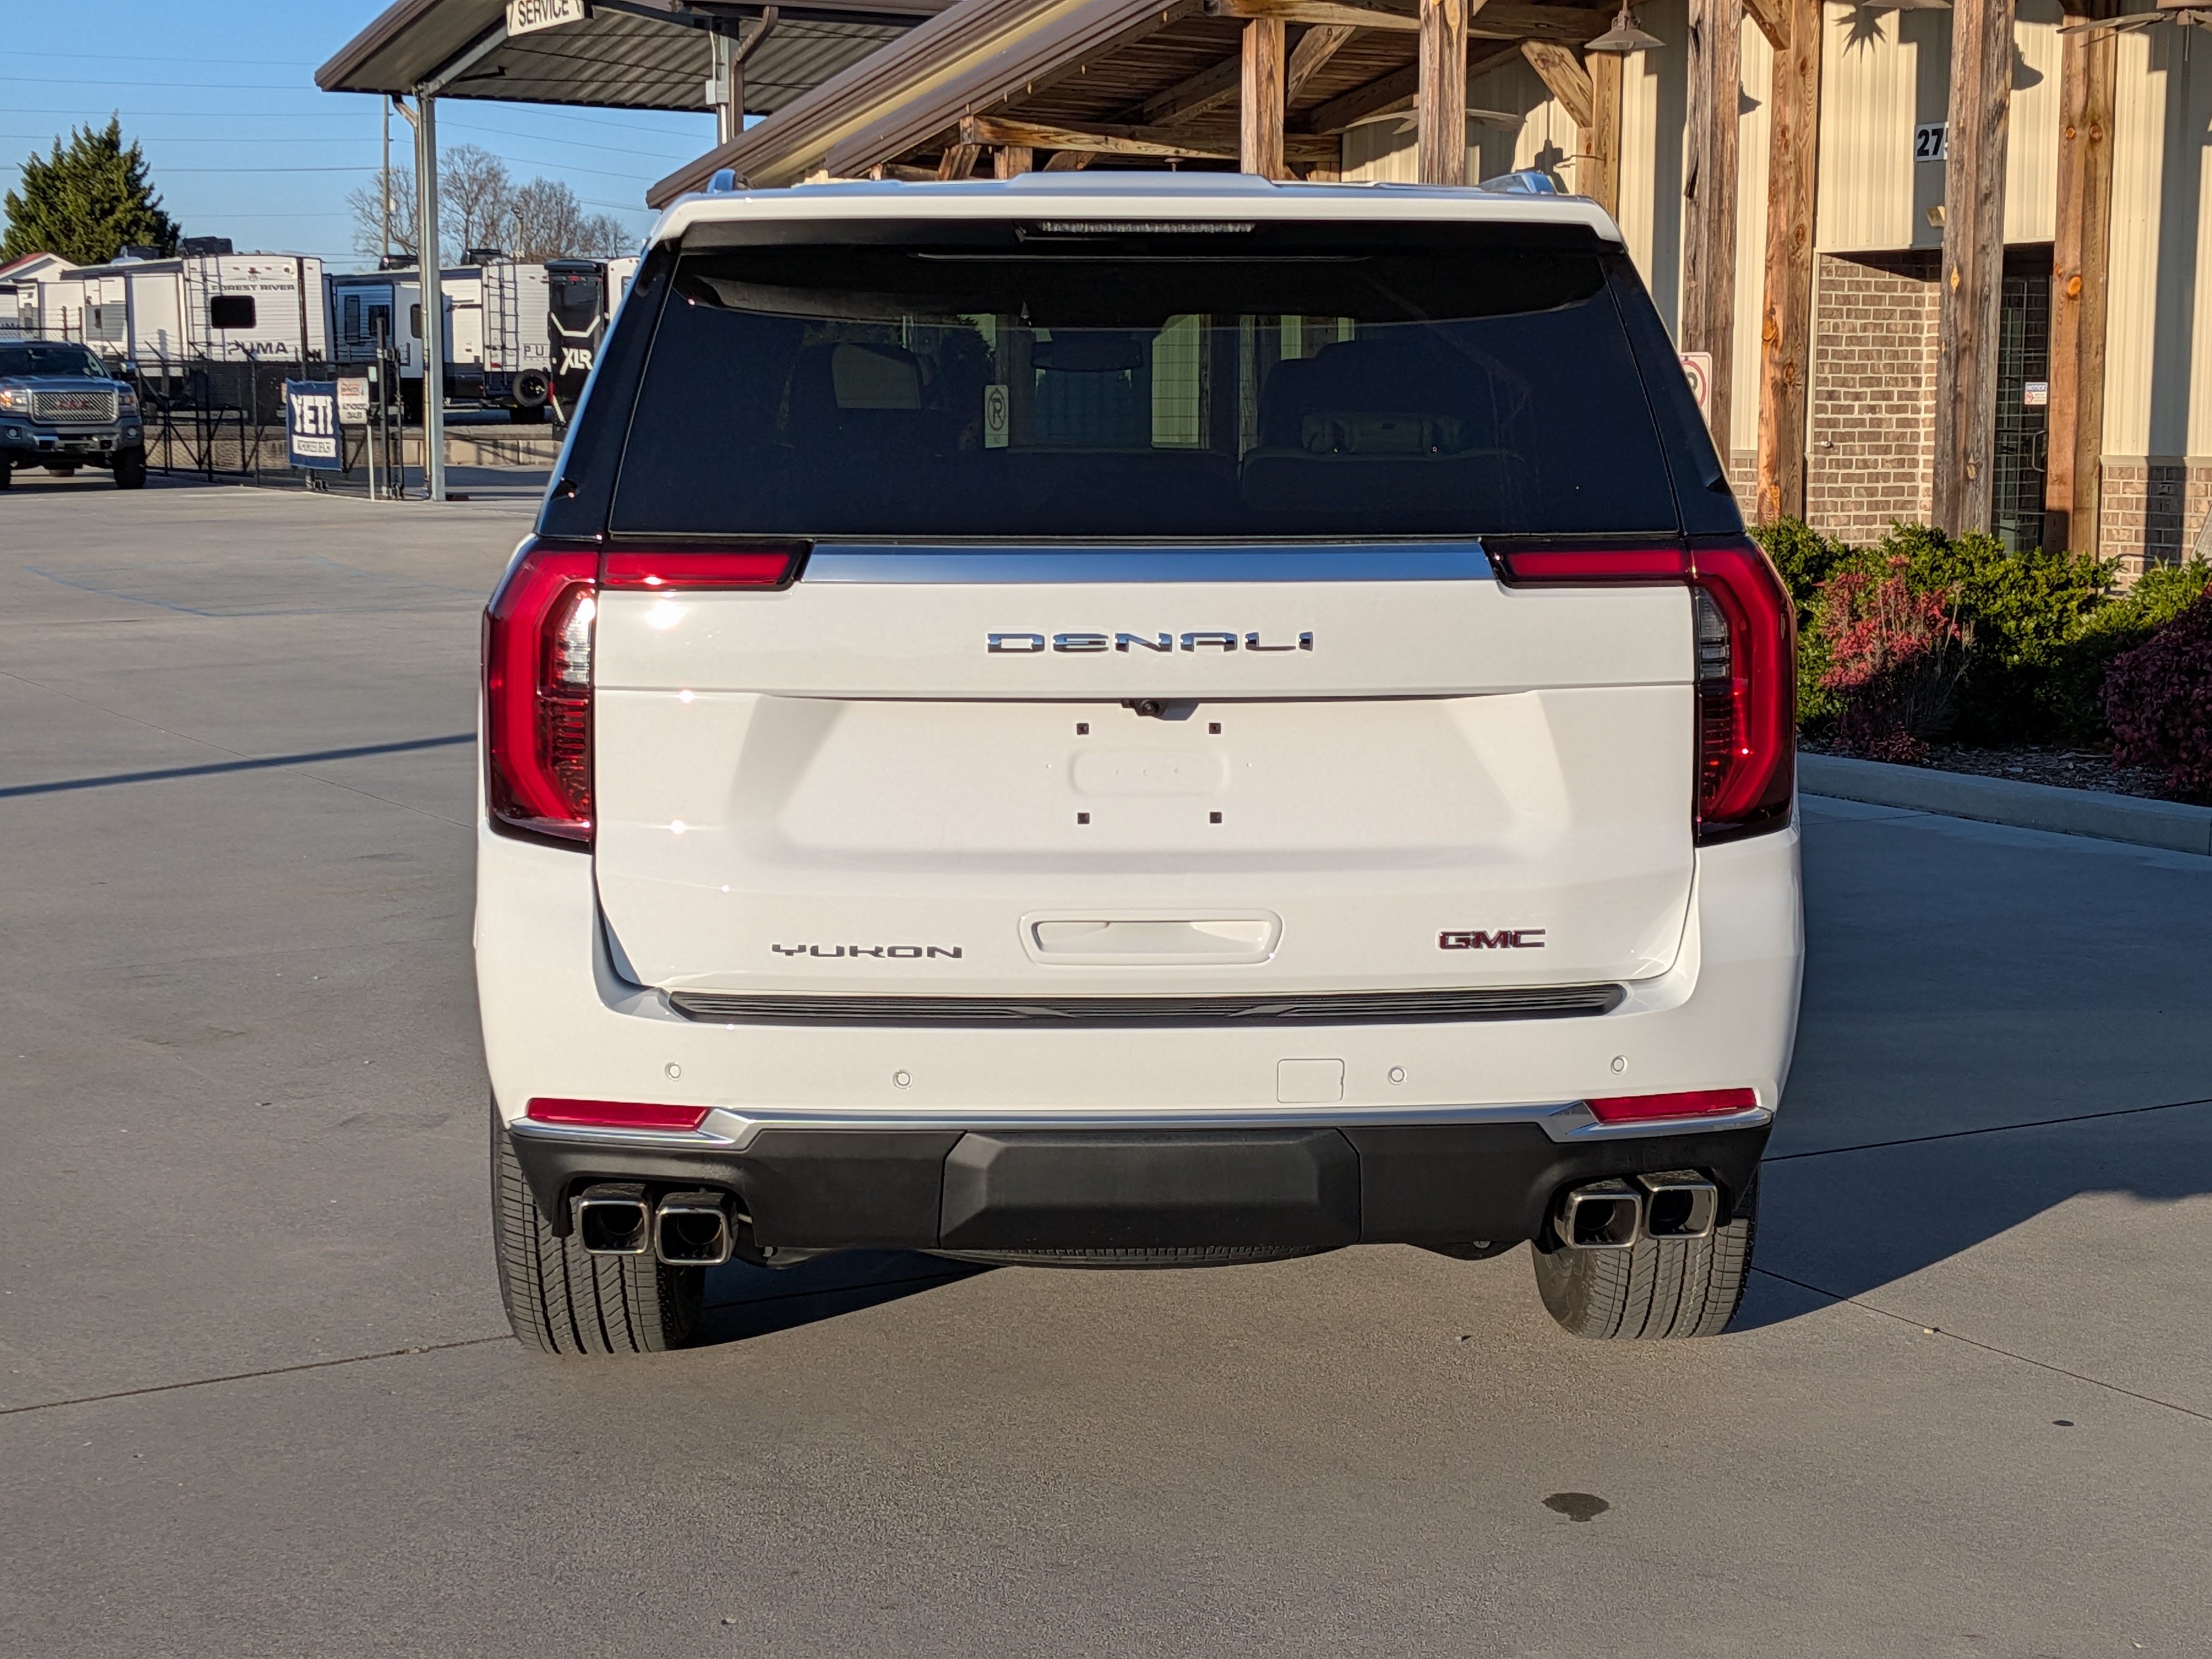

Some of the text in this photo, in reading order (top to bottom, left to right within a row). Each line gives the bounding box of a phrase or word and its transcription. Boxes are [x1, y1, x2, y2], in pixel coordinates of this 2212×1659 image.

[518, 0, 569, 27] SERVICE
[1917, 128, 1948, 157] 27
[524, 346, 544, 356] PU
[560, 347, 593, 375] XLR
[290, 393, 333, 434] YETI
[987, 632, 1313, 653] DENALI
[772, 944, 962, 958] YUKON
[1439, 929, 1546, 950] GMC
